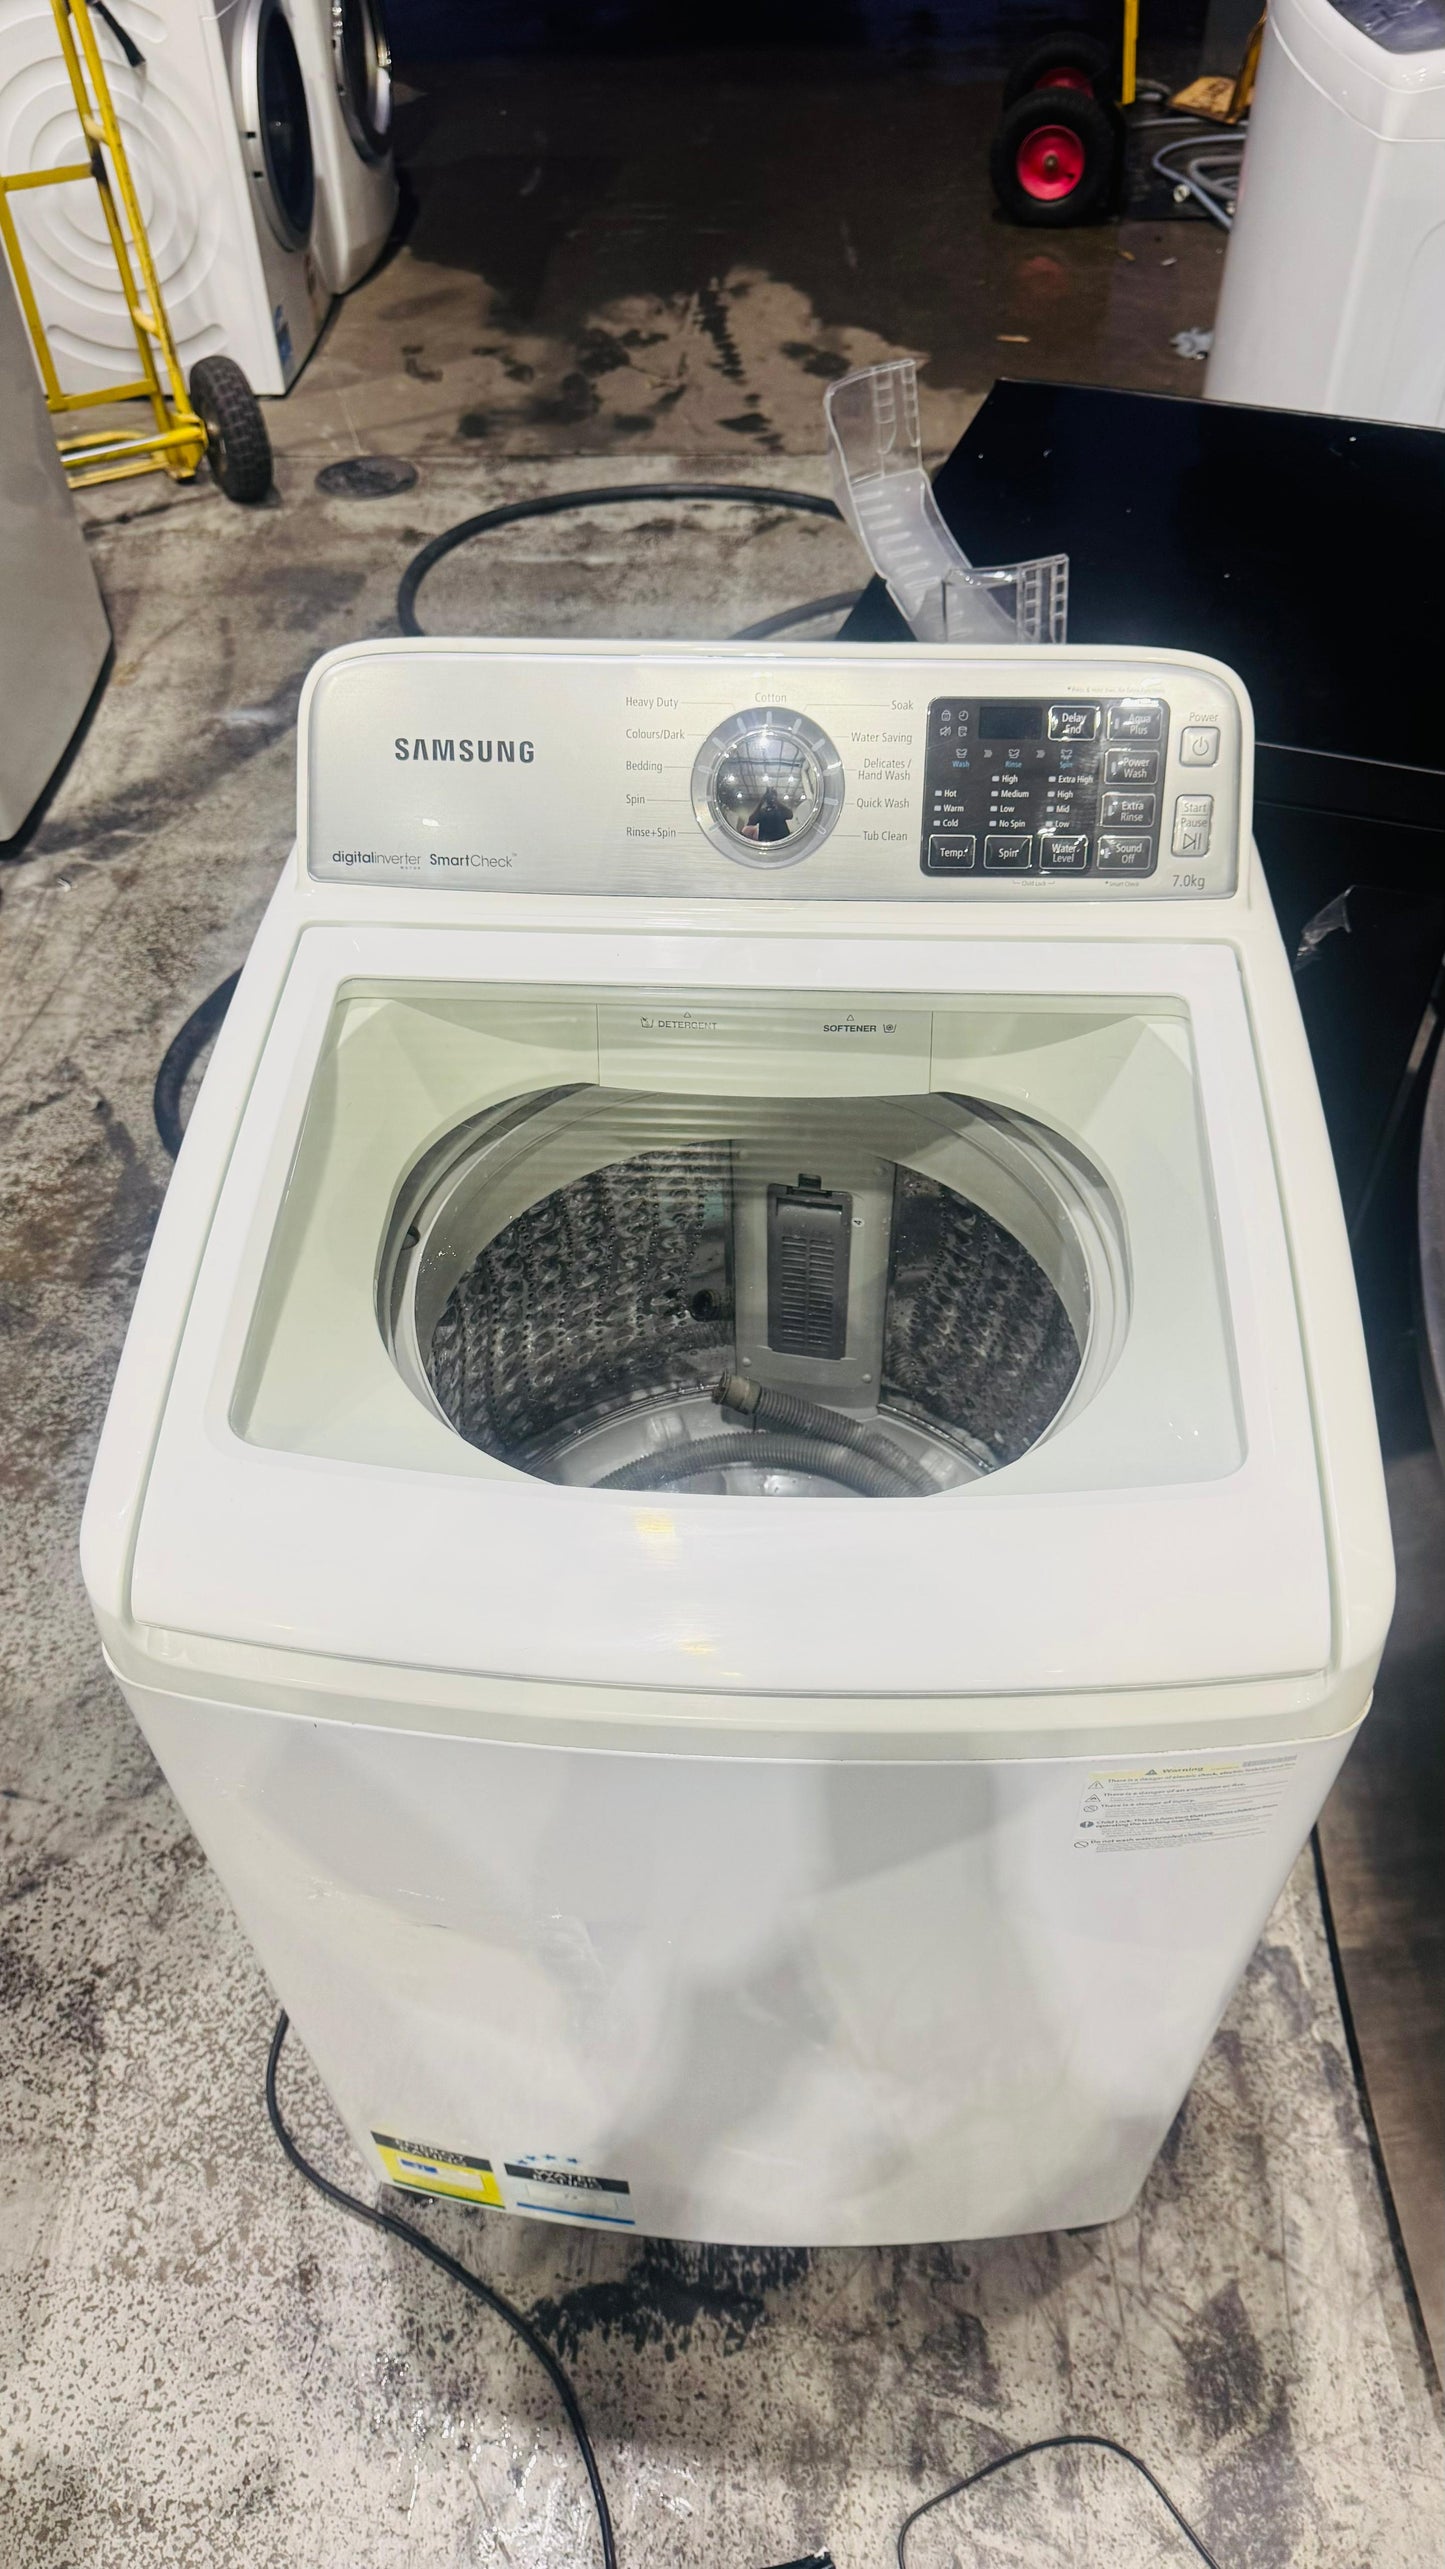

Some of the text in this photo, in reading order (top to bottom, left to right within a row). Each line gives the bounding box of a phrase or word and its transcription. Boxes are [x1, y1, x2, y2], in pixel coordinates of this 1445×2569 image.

[754, 691, 787, 703] Cotton
[625, 696, 679, 709] Heavy Duty
[891, 700, 914, 710] Soak
[1061, 712, 1087, 725] Delay
[1128, 713, 1151, 724] Aqua
[1189, 712, 1218, 722] Power
[625, 728, 685, 740] Colours/Dark
[1064, 725, 1082, 734] End
[1129, 725, 1148, 735] Plus
[851, 732, 913, 745] Water Saving
[394, 737, 535, 763] SAMSUNG
[625, 760, 663, 774] Bedding
[863, 758, 905, 768] Delicates
[951, 760, 970, 768] Wash
[1122, 757, 1150, 767] Power
[858, 770, 911, 780] Hand Wash
[1123, 768, 1148, 778] Wash
[1001, 774, 1019, 784] High
[1058, 775, 1094, 785] Extra High
[944, 789, 957, 798] Hot
[1000, 789, 1030, 798] Medium
[1057, 790, 1074, 800] High
[625, 794, 646, 806] Spin
[856, 798, 910, 809] Quick Wash
[943, 804, 965, 812] Warm
[1000, 804, 1015, 813] Low
[1055, 805, 1070, 813] Mid
[1121, 801, 1144, 811] Extra
[1183, 802, 1207, 813] Start
[1120, 812, 1144, 822] Rinse
[942, 818, 959, 827] Cold
[998, 820, 1026, 829] No Spin
[1055, 820, 1070, 828] Low
[1180, 817, 1208, 828] Pause
[626, 826, 677, 839] Rinse+Spin
[863, 830, 908, 841] Tub Clean
[940, 847, 966, 859] Temp.
[998, 847, 1018, 859] Spin
[1051, 843, 1077, 854] Water
[1115, 843, 1143, 853] Sound
[1052, 854, 1075, 863] Level
[1121, 854, 1136, 864] Off
[1172, 874, 1206, 890] 7.0kg
[658, 1020, 717, 1030] DETERGENT
[823, 1024, 877, 1033] SOFTENER
